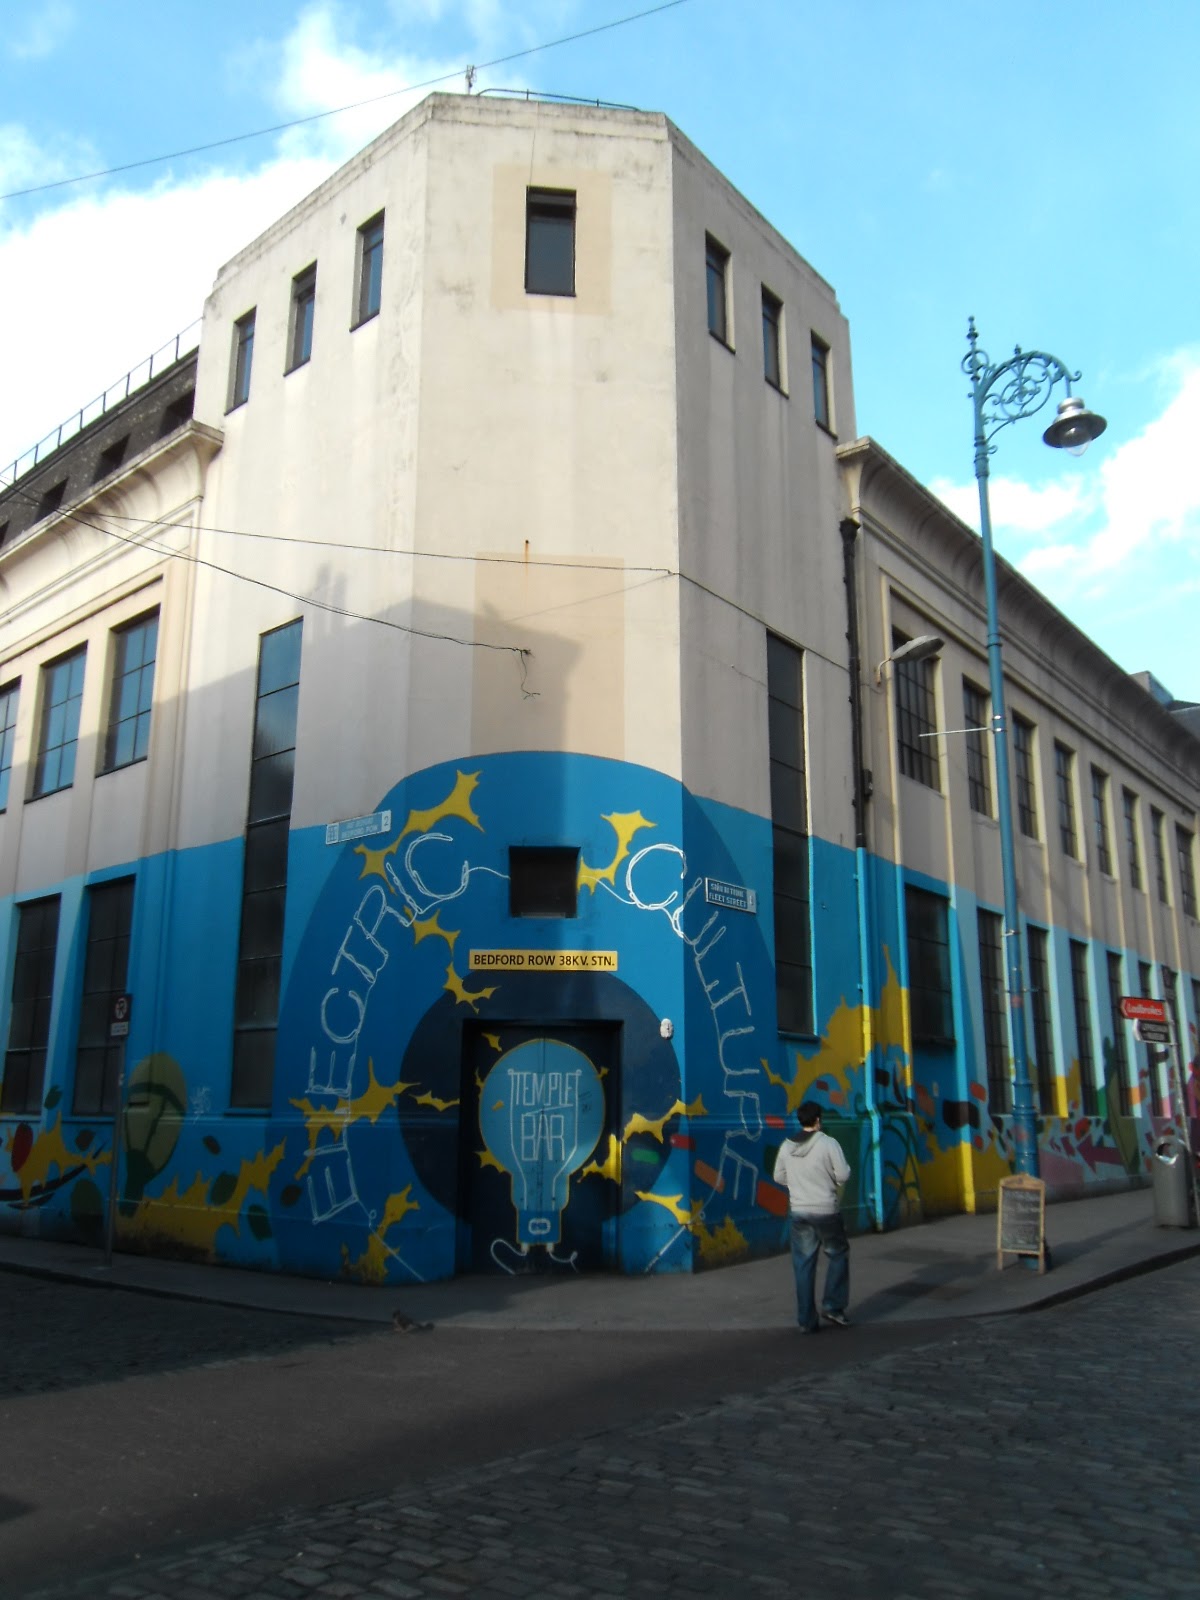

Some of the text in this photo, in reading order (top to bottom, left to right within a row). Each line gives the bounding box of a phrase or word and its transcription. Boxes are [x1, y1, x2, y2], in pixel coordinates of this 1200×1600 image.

[384, 815, 389, 827] 2
[709, 892, 725, 902] FLEET
[727, 896, 746, 908] STREET
[474, 954, 615, 966] BEDFORD ROW 38KV. STN.
[304, 833, 468, 1224] ELECTRIC
[625, 843, 762, 1206] CULTURE
[509, 1071, 580, 1107] TEMPLE
[521, 1113, 565, 1161] BAR
